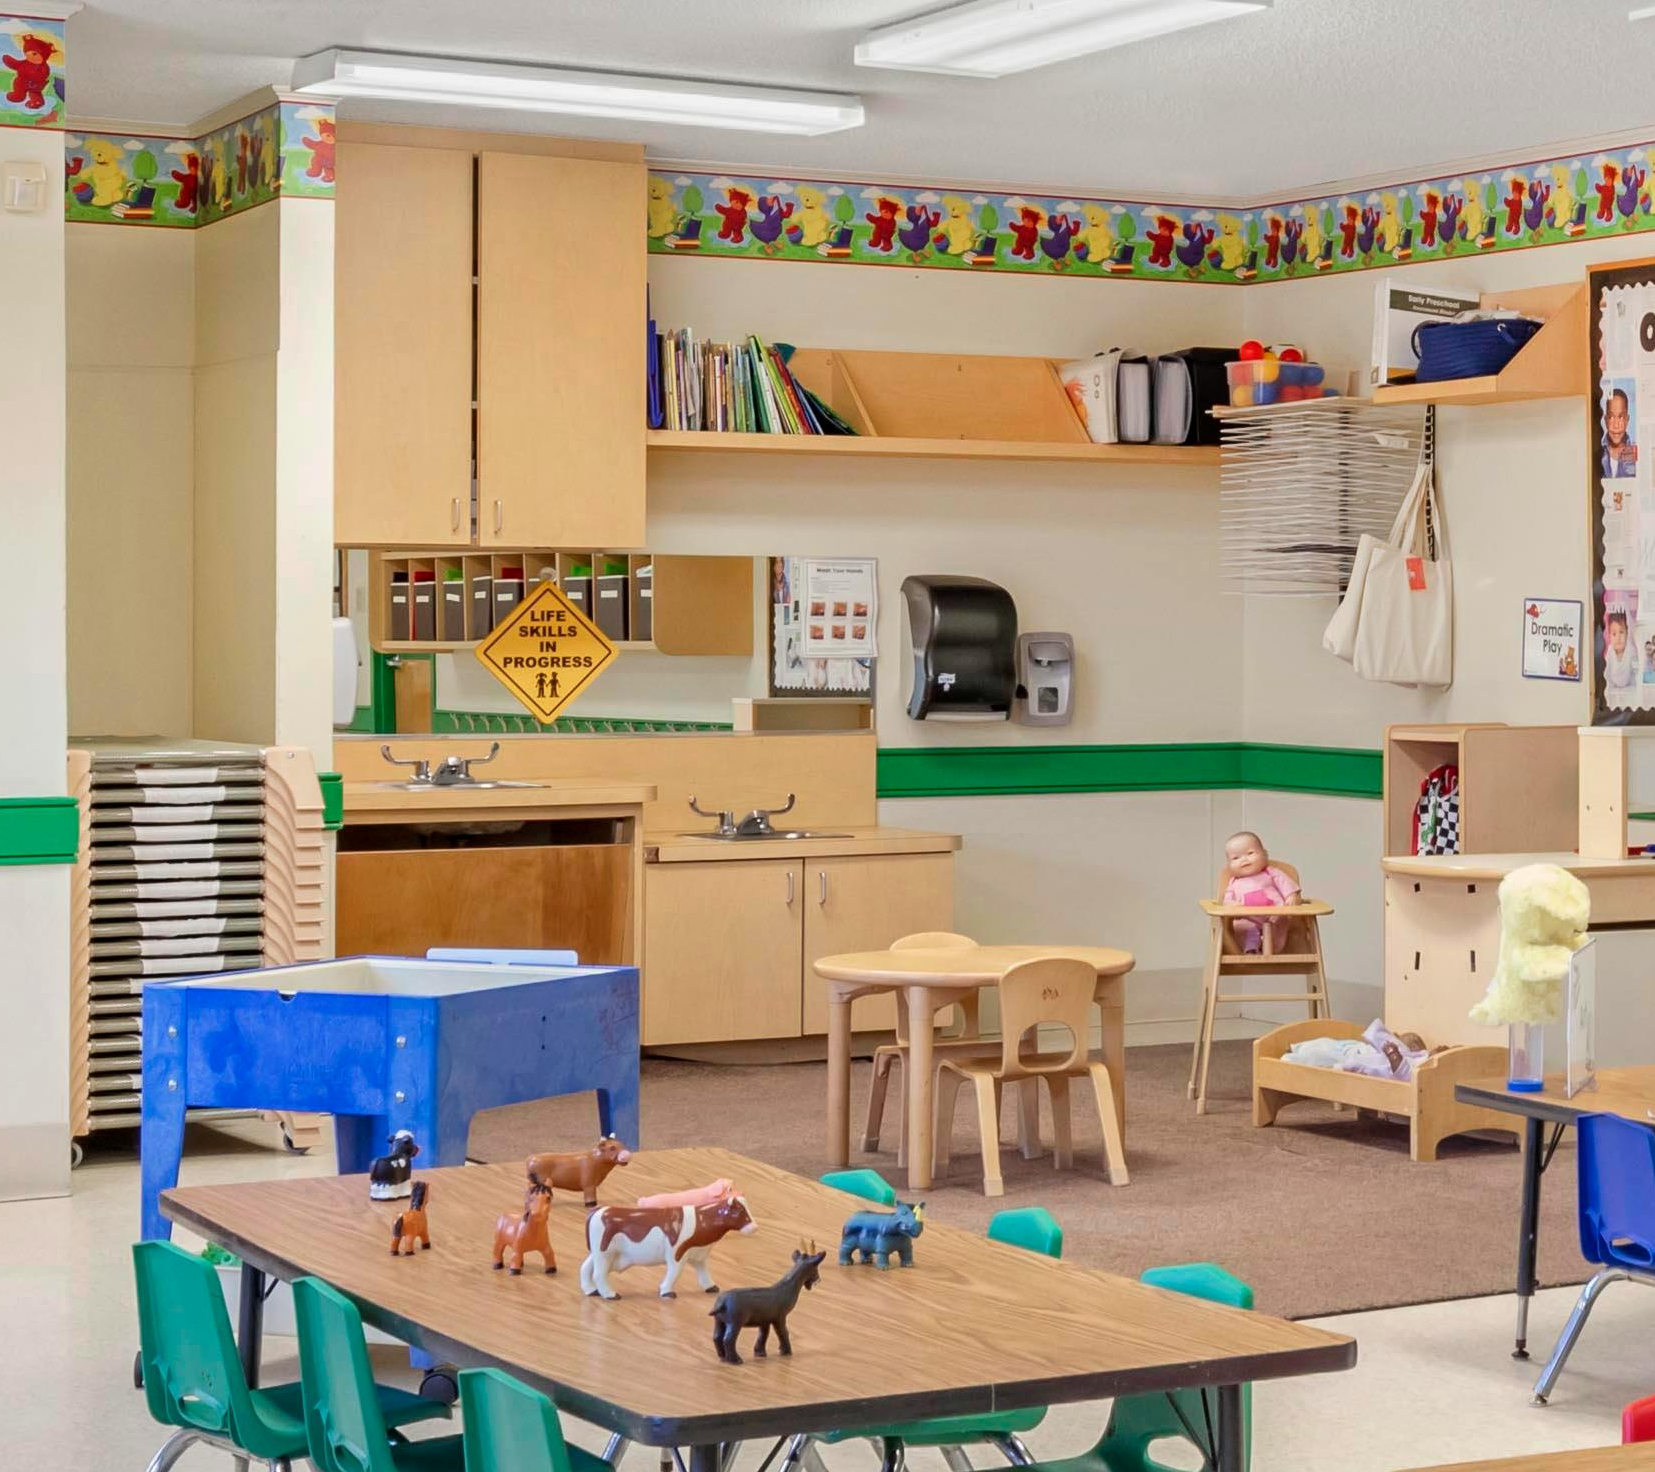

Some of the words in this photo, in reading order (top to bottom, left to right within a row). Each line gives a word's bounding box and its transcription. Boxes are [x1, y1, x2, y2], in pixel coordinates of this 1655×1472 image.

[530, 610, 566, 622] LIFE
[518, 625, 578, 638] SKILLS
[1531, 621, 1574, 638] Dramatic
[539, 640, 557, 653] IN
[1543, 639, 1562, 656] Play
[503, 656, 593, 669] PROGRESS
